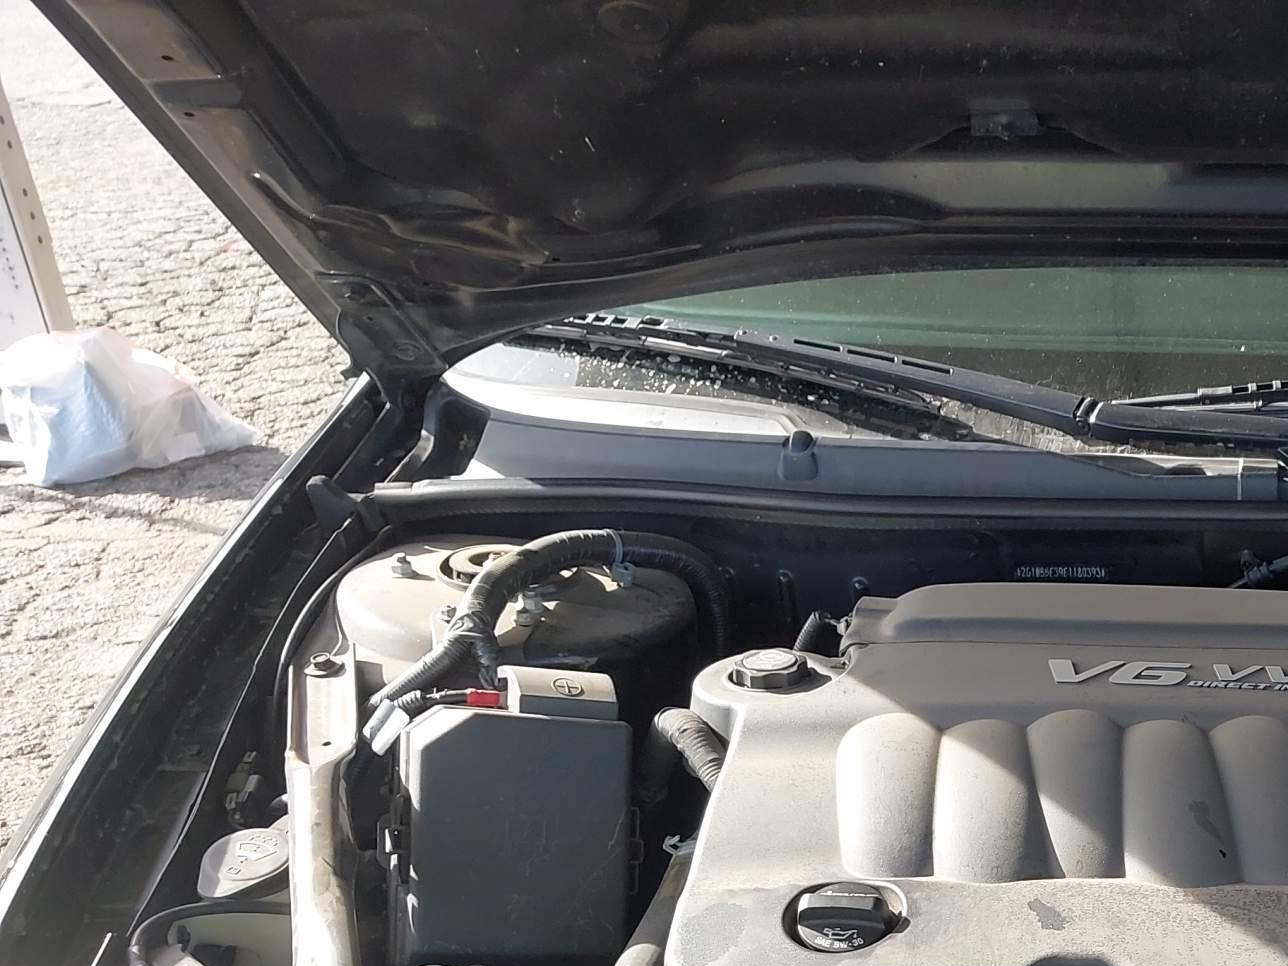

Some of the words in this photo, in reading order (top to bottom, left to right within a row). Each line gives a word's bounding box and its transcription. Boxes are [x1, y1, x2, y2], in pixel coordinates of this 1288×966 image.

[1048, 658, 1192, 687] V6
[1187, 679, 1275, 690] DIRECT
[815, 936, 832, 947] SAE
[833, 938, 864, 949] 5W-30
